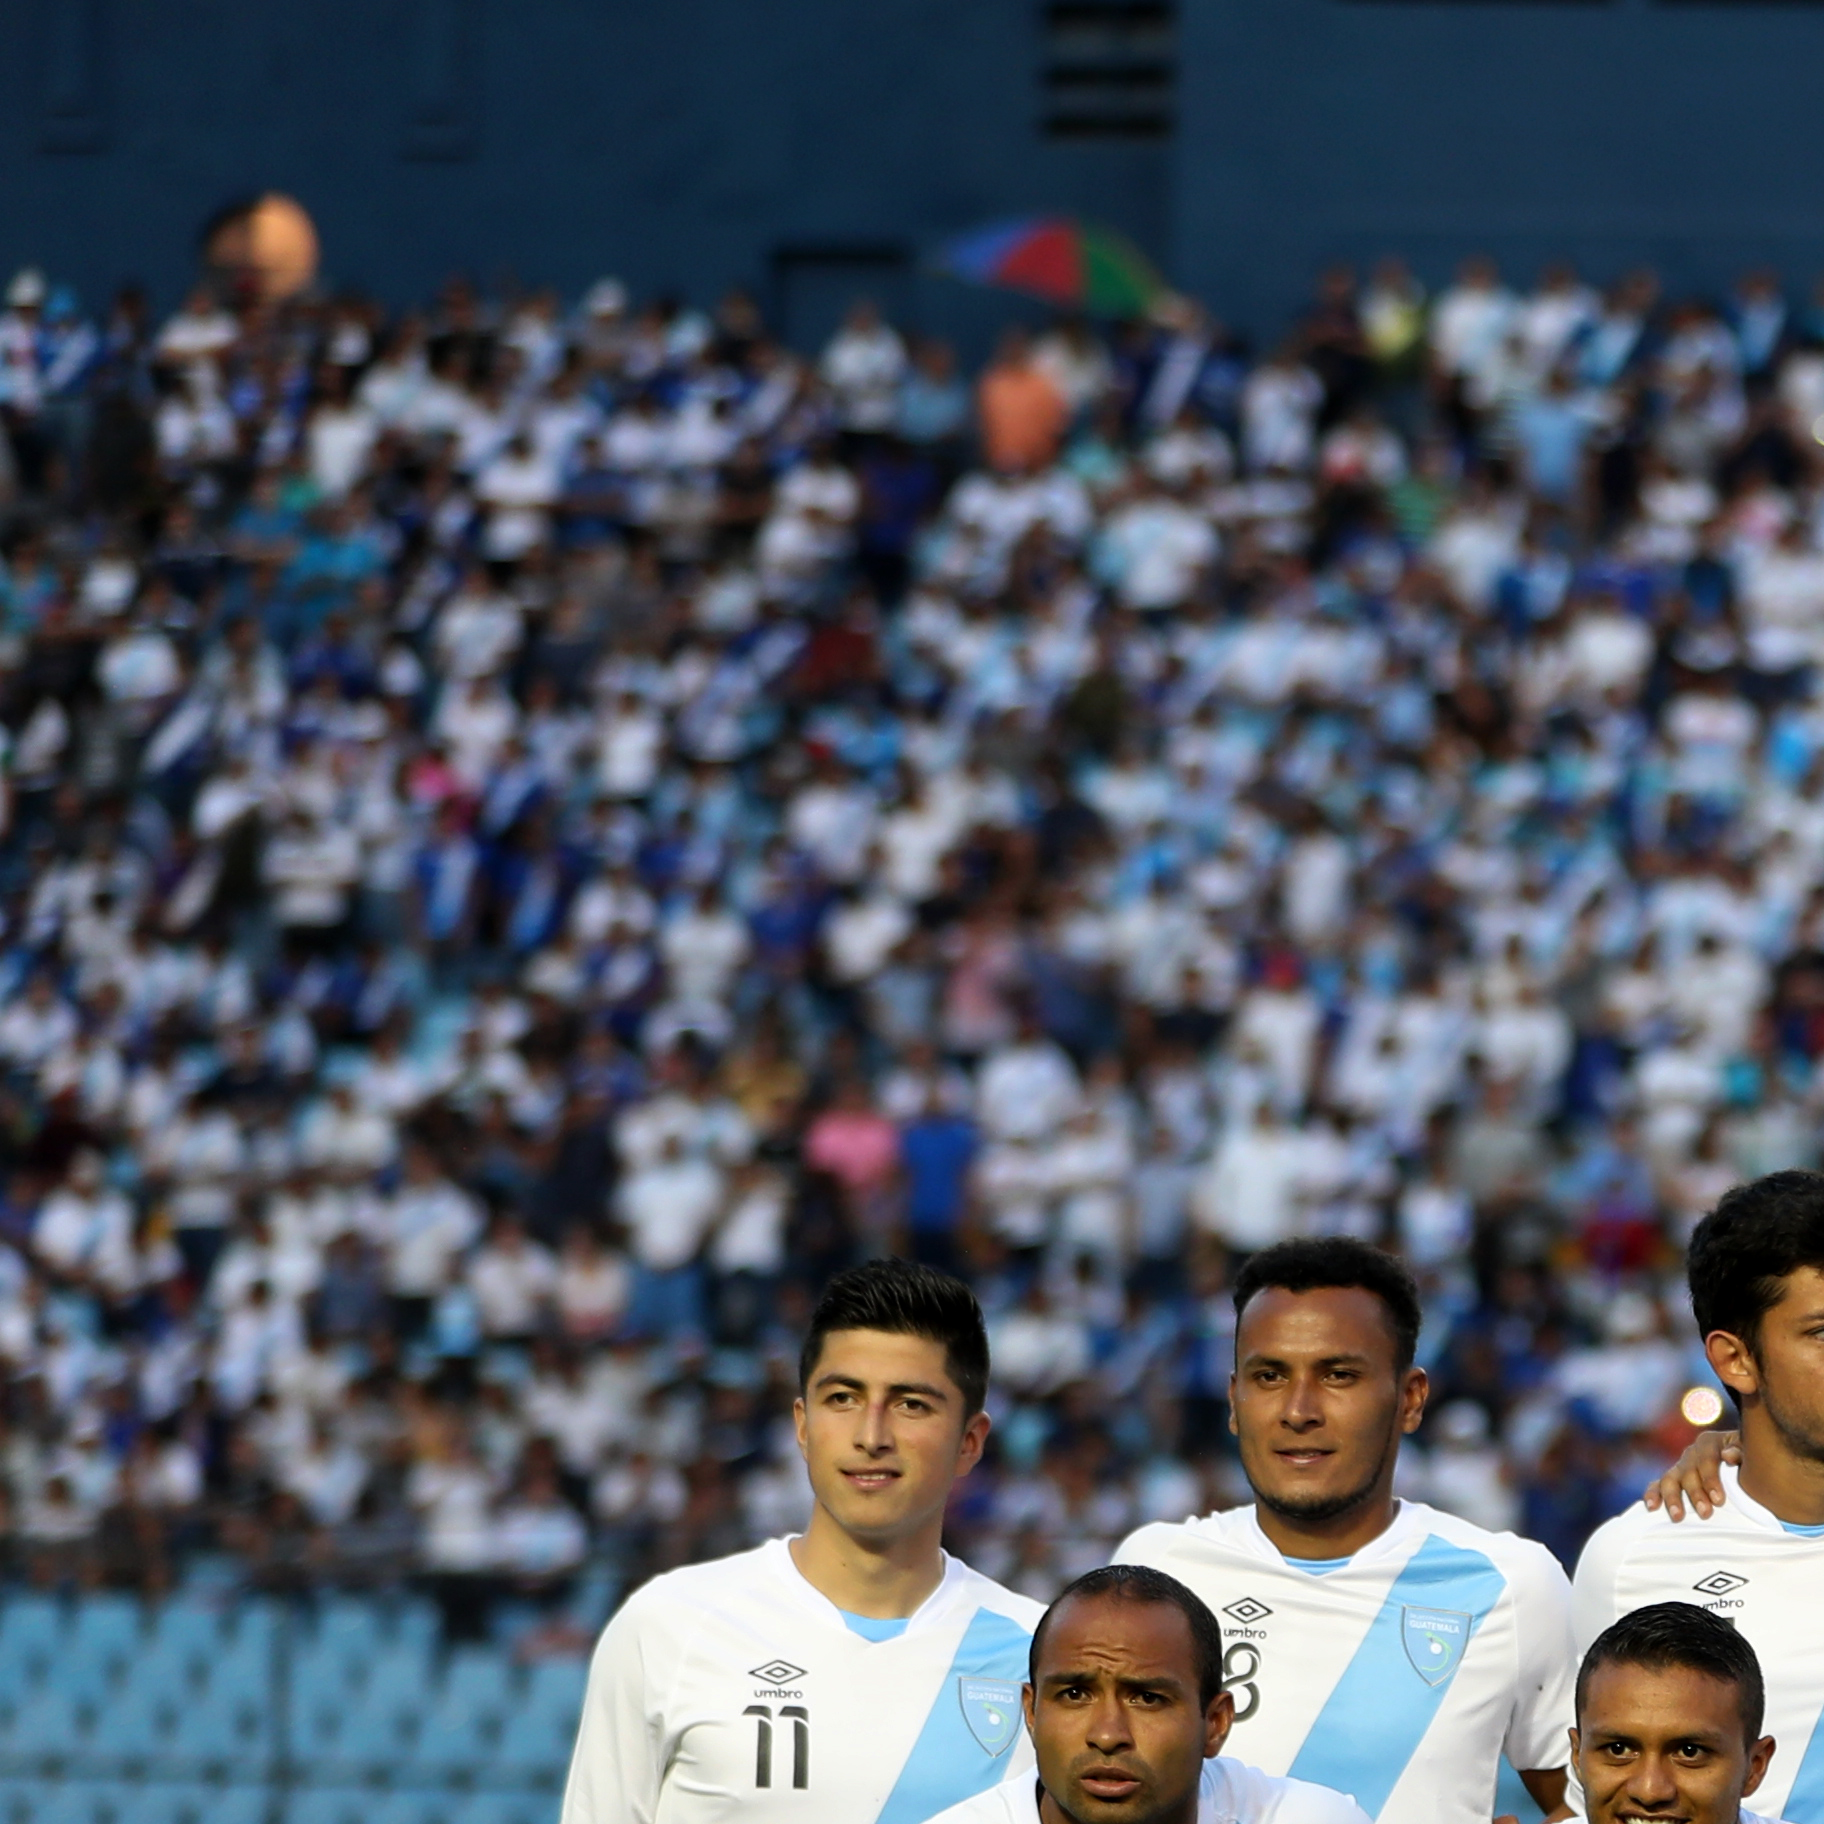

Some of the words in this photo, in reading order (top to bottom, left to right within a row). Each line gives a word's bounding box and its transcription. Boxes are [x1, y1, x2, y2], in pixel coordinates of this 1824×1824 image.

[1223, 1627, 1267, 1640] umbro
[1409, 1619, 1460, 1635] GUATEMALA
[753, 1688, 804, 1700] umbro
[967, 1690, 1015, 1704] GUATEMALA
[742, 1705, 809, 1790] 11
